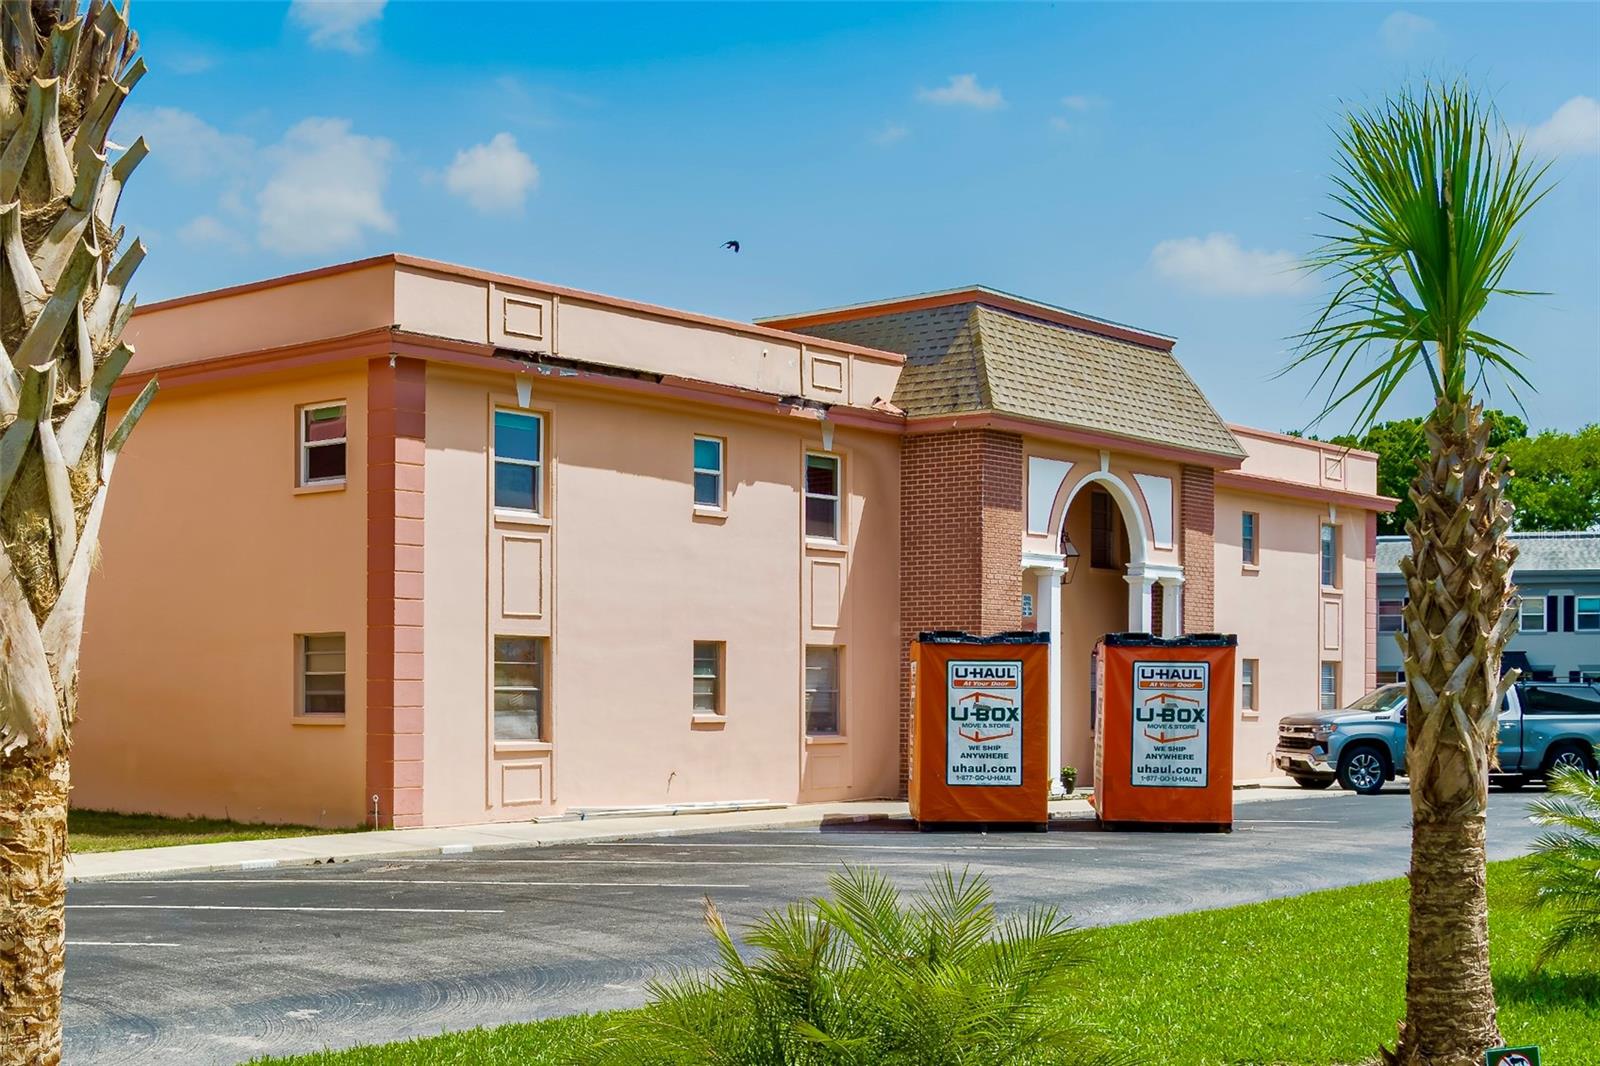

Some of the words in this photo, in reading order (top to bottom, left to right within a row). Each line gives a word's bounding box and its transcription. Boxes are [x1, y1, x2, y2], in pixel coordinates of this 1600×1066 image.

[955, 668, 1015, 678] U-HAUL
[1141, 669, 1202, 680] U-HAUL
[951, 707, 1019, 721] U-BOX
[1136, 708, 1205, 723] U-BOX
[952, 764, 1017, 773] uhaul.com
[1137, 765, 1202, 774] uhaul.com
